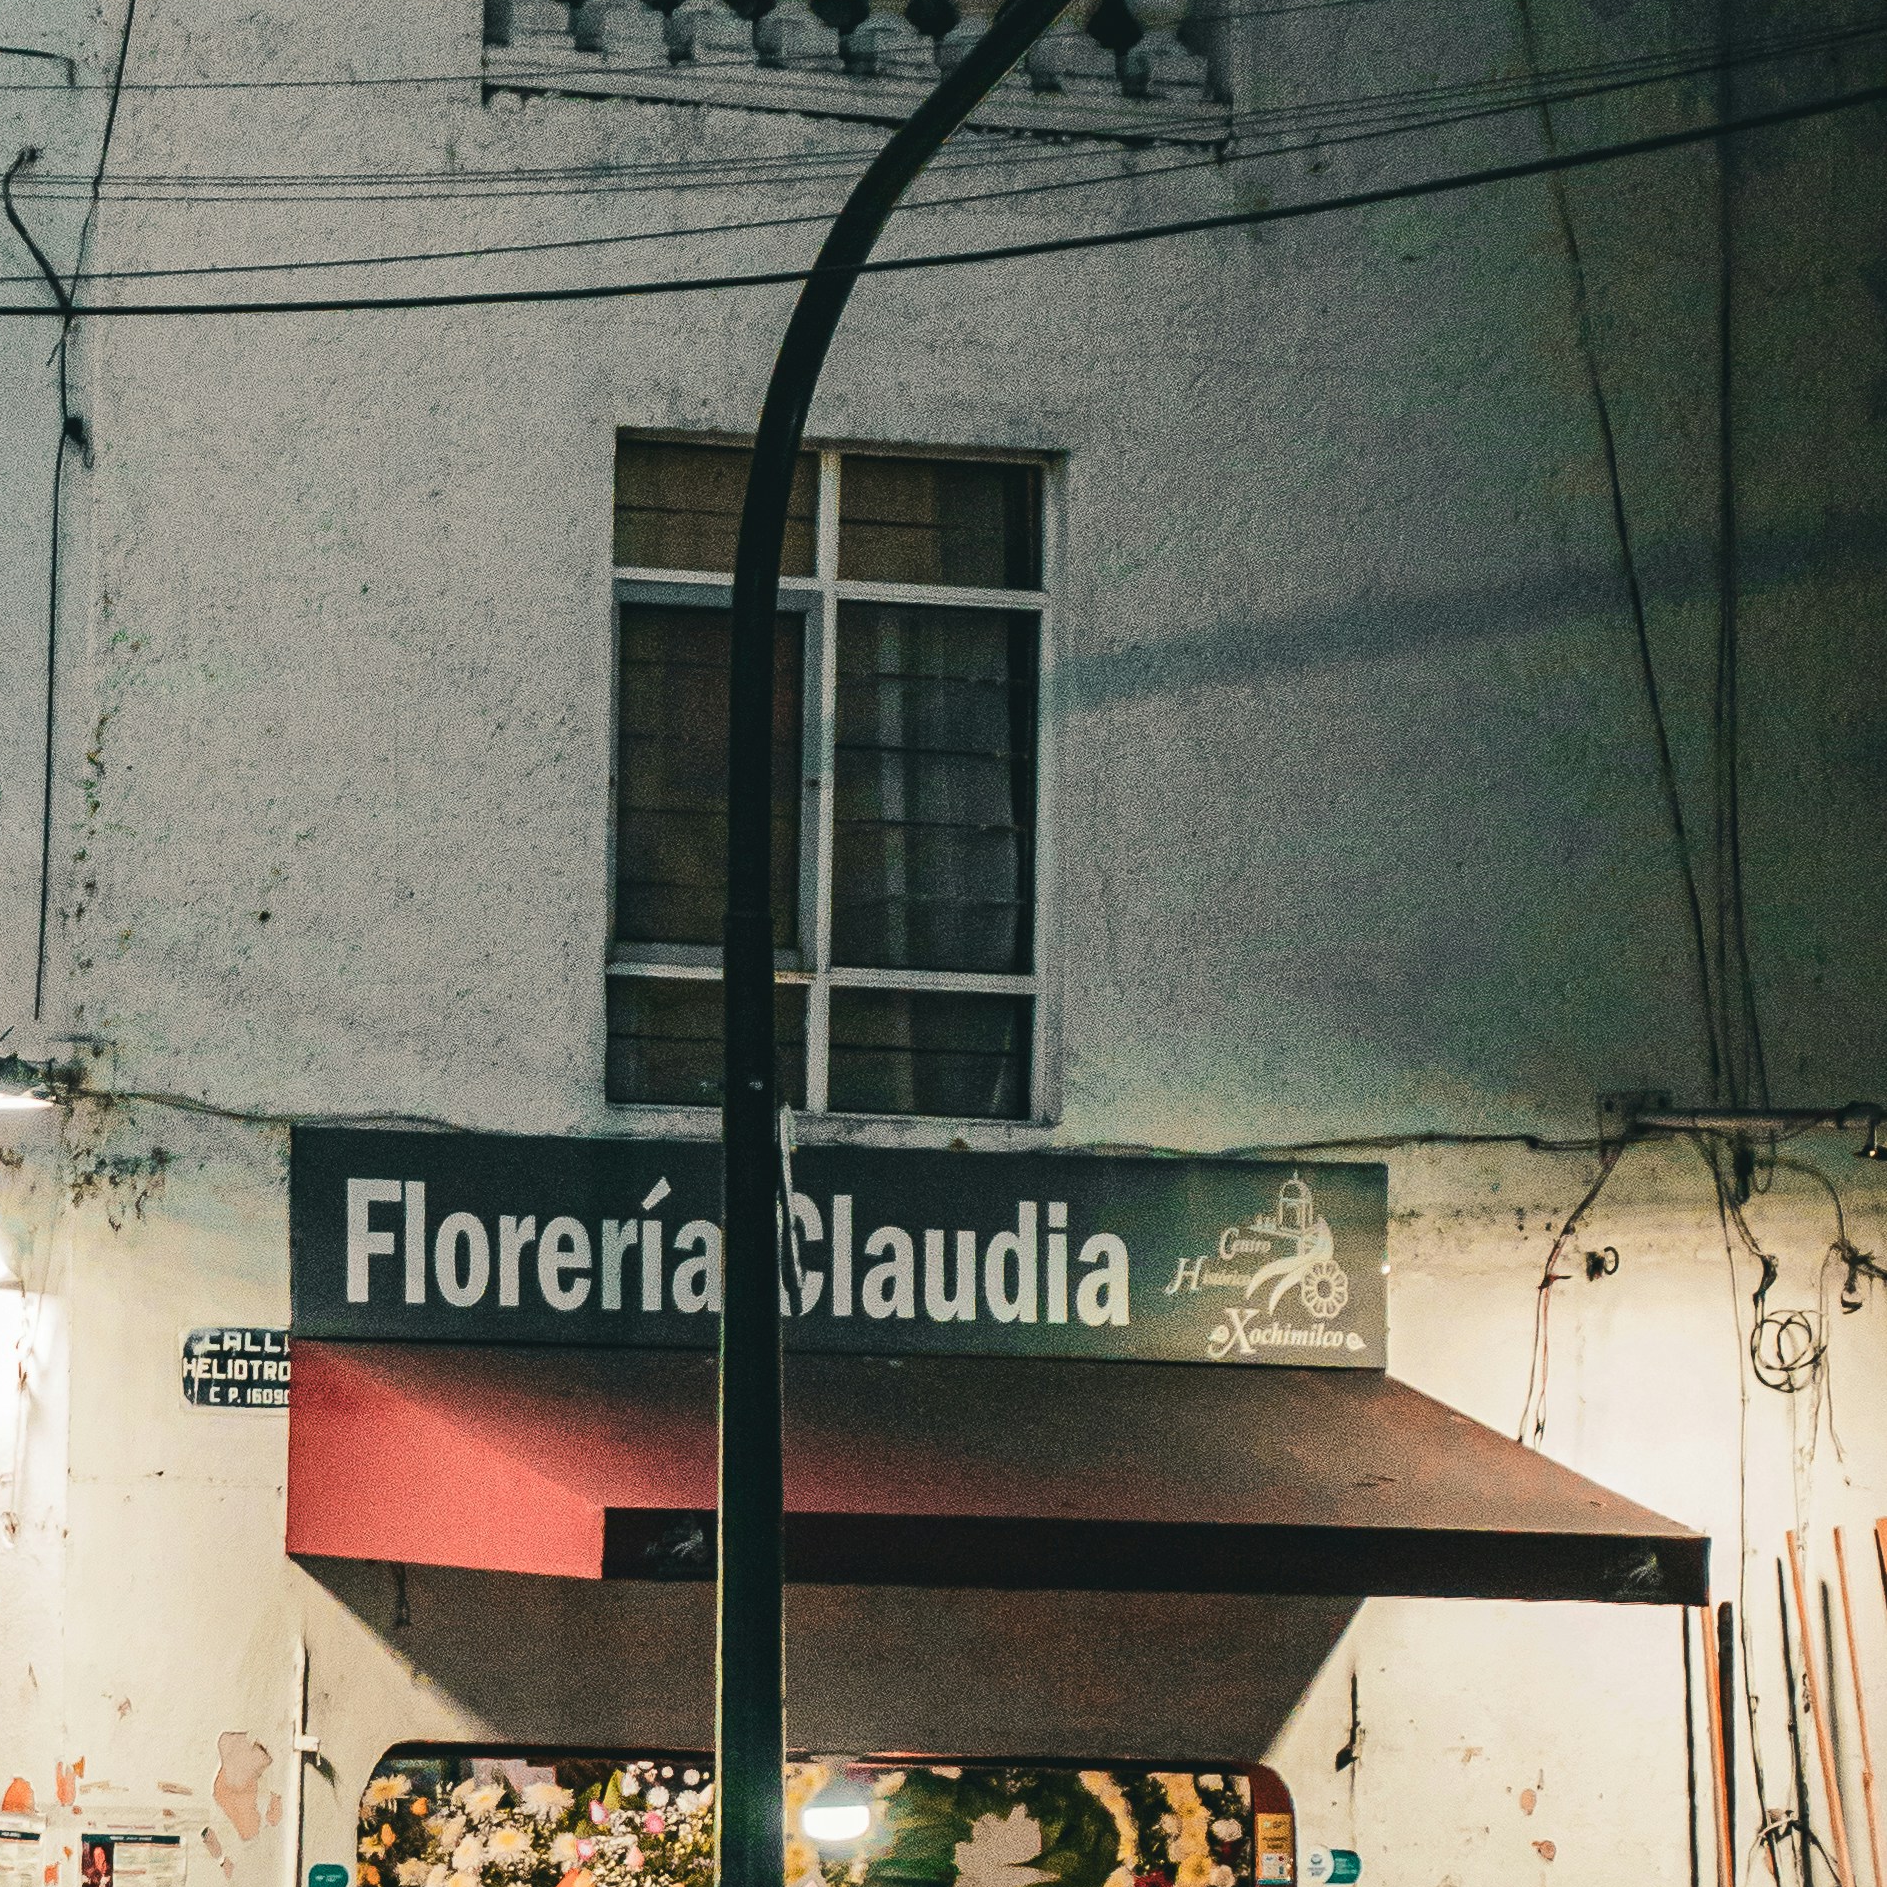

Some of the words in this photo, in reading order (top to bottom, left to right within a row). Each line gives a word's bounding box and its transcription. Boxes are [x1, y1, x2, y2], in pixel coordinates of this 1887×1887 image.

[346, 1176, 722, 1313] Florería
[781, 1196, 1130, 1326] Claudia
[1207, 1308, 1344, 1358] Xochimilco
